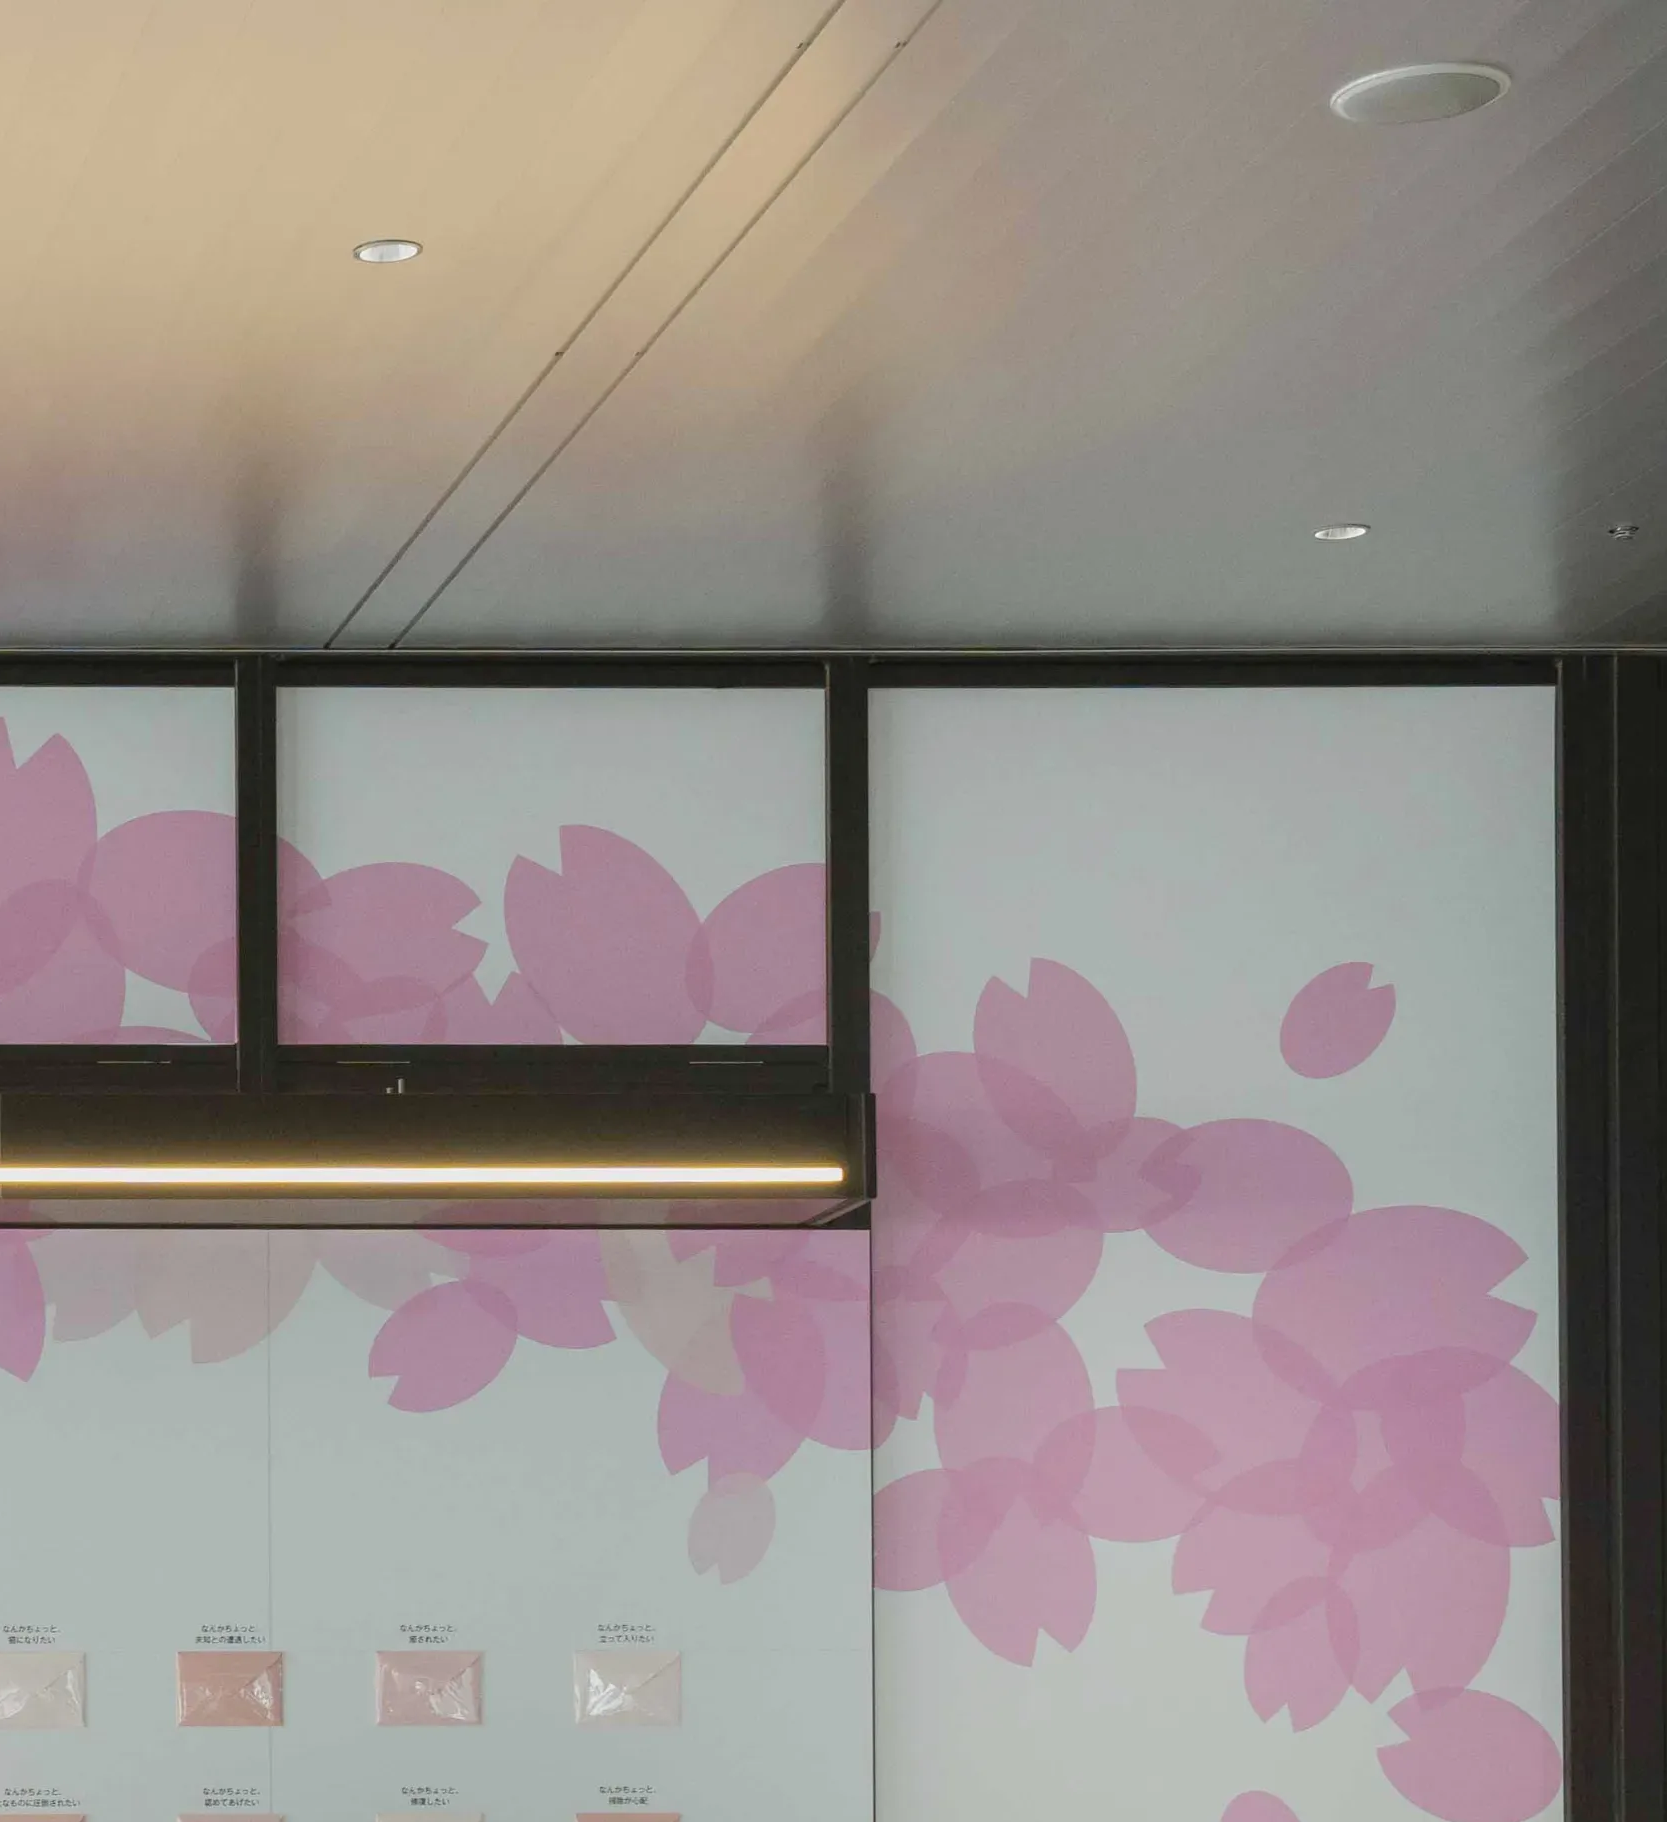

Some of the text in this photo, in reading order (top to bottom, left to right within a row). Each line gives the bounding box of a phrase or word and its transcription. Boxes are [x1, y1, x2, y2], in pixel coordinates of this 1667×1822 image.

[3, 1624, 61, 1634] なんかちょっと、
[400, 1624, 457, 1632] なんかちょっと、
[597, 1624, 655, 1633] なんかちょっと、
[4, 1788, 62, 1797] なんかちょっと、
[203, 1788, 260, 1796] なんかちょっと、
[402, 1786, 459, 1796] なんかちょっと、
[599, 1785, 656, 1795] なんかちょっと、
